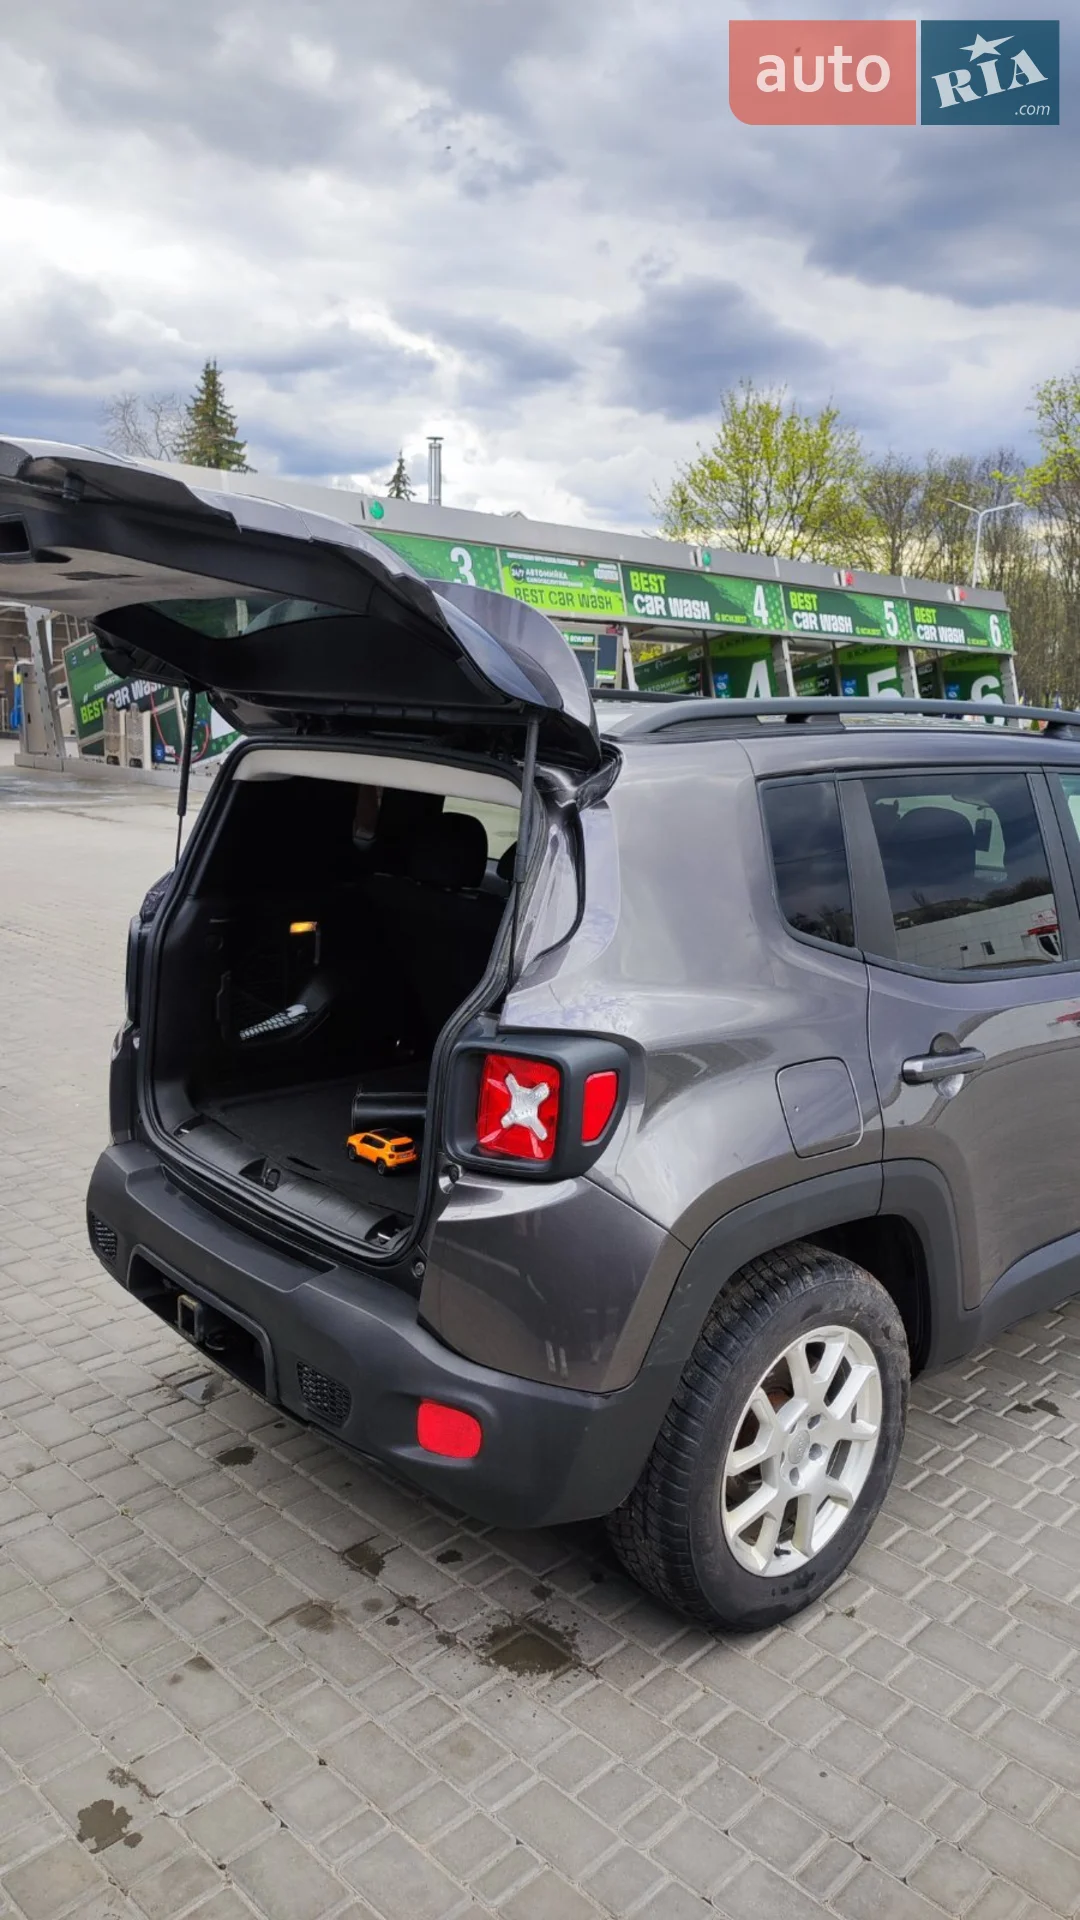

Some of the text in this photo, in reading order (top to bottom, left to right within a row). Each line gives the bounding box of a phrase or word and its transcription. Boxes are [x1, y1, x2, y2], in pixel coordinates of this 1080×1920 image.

[450, 546, 476, 587] 3
[514, 587, 545, 604] BEST
[629, 570, 666, 595] BEST
[753, 584, 769, 626] 4
[788, 590, 818, 611] BEST
[883, 600, 899, 637] 5
[913, 606, 937, 625] BEST
[989, 613, 1003, 648] 6
[80, 697, 105, 725] BEST
